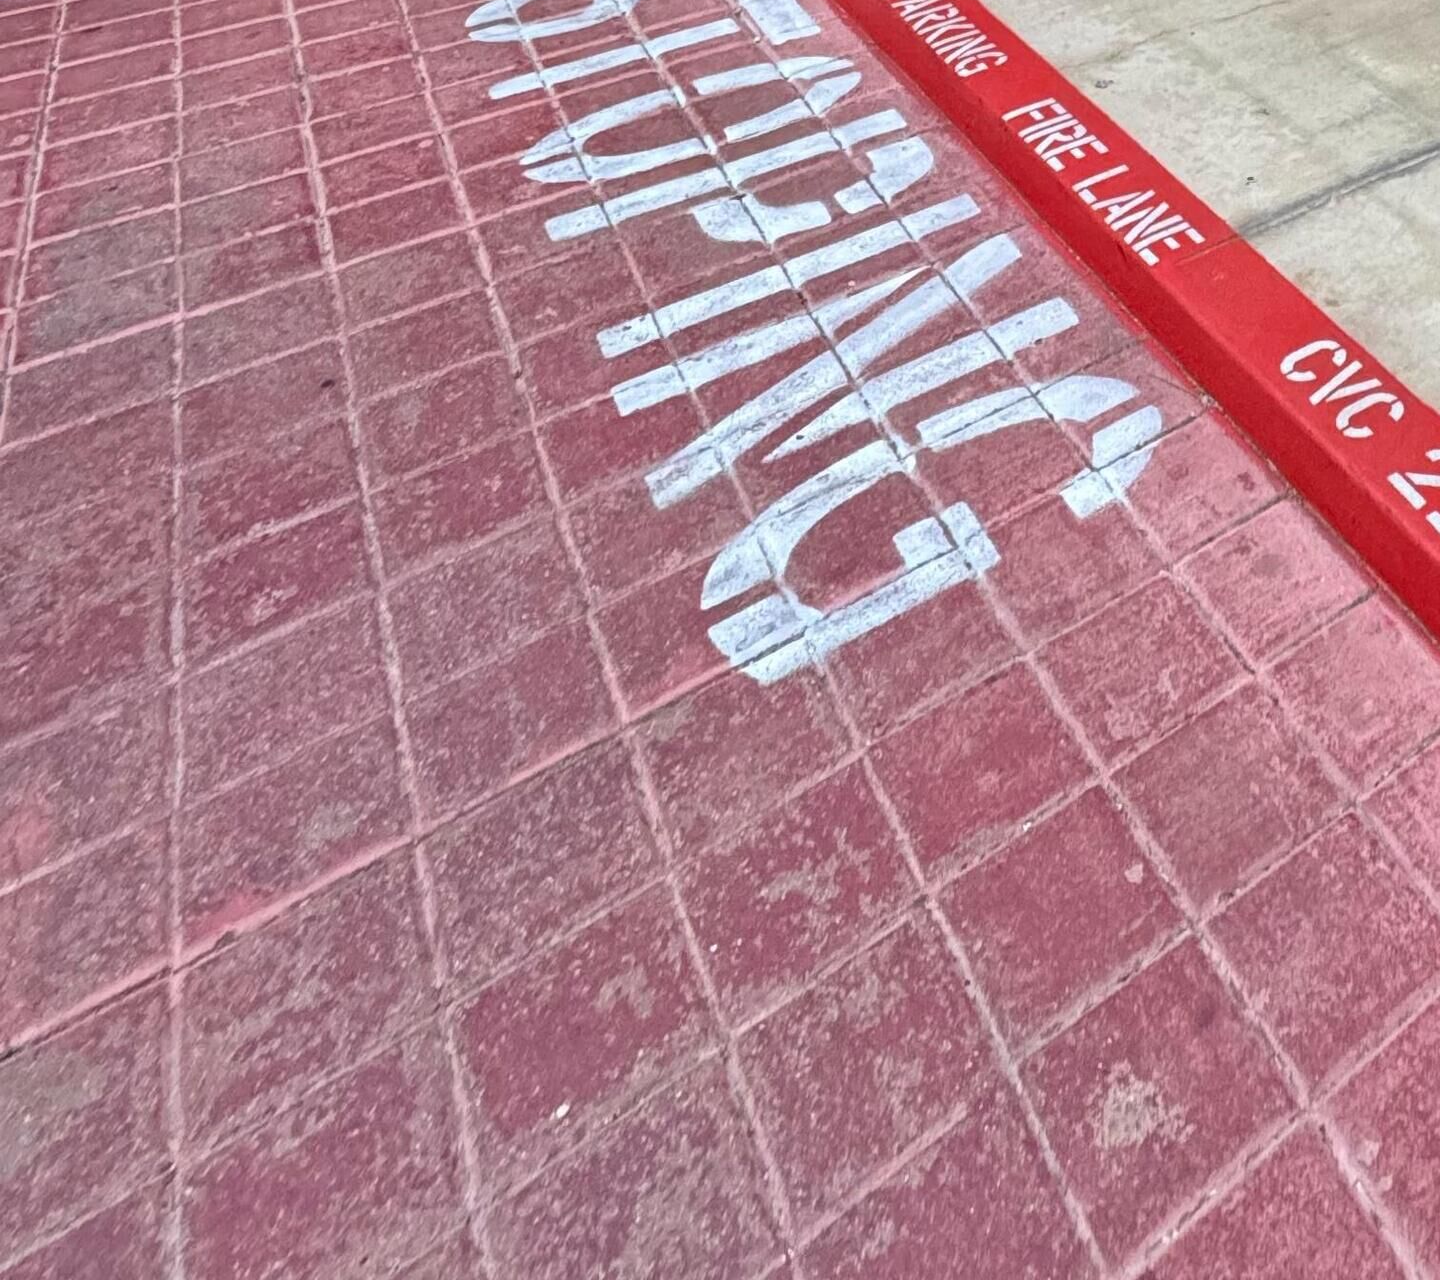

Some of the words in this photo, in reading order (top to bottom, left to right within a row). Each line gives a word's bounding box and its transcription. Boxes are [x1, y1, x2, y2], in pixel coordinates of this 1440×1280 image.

[1001, 97, 1109, 172] FIRE
[1072, 164, 1206, 267] LANE
[1280, 339, 1405, 439] CVC
